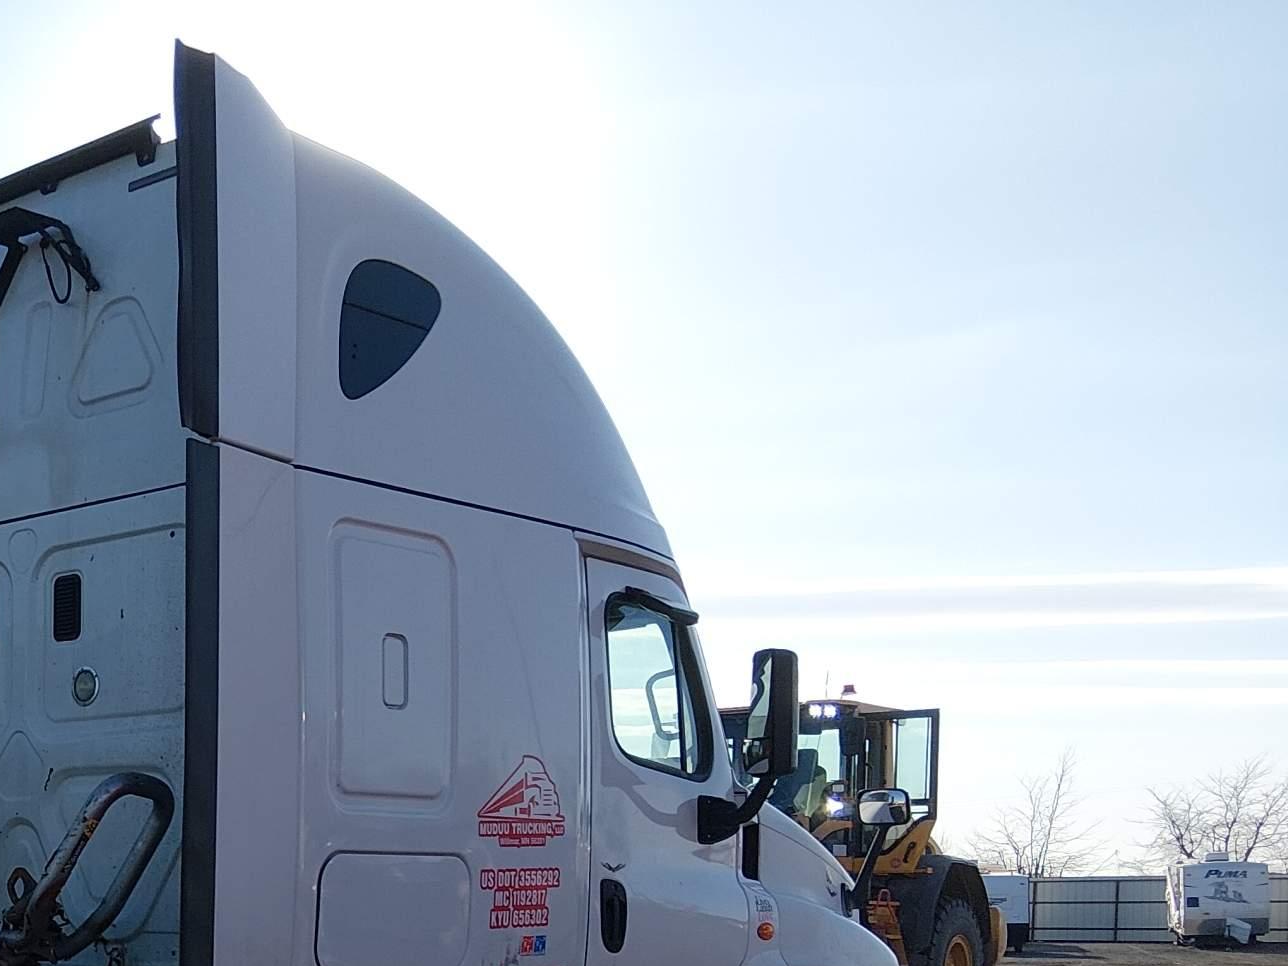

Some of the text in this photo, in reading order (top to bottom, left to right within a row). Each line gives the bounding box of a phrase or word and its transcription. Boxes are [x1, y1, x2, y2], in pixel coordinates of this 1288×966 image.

[480, 822, 511, 836] MUDUU
[512, 822, 554, 836] TRUCKING,
[482, 869, 560, 888] US DOT 3556292
[495, 889, 547, 907] MC 1192817
[490, 908, 548, 927] KYU 656302
